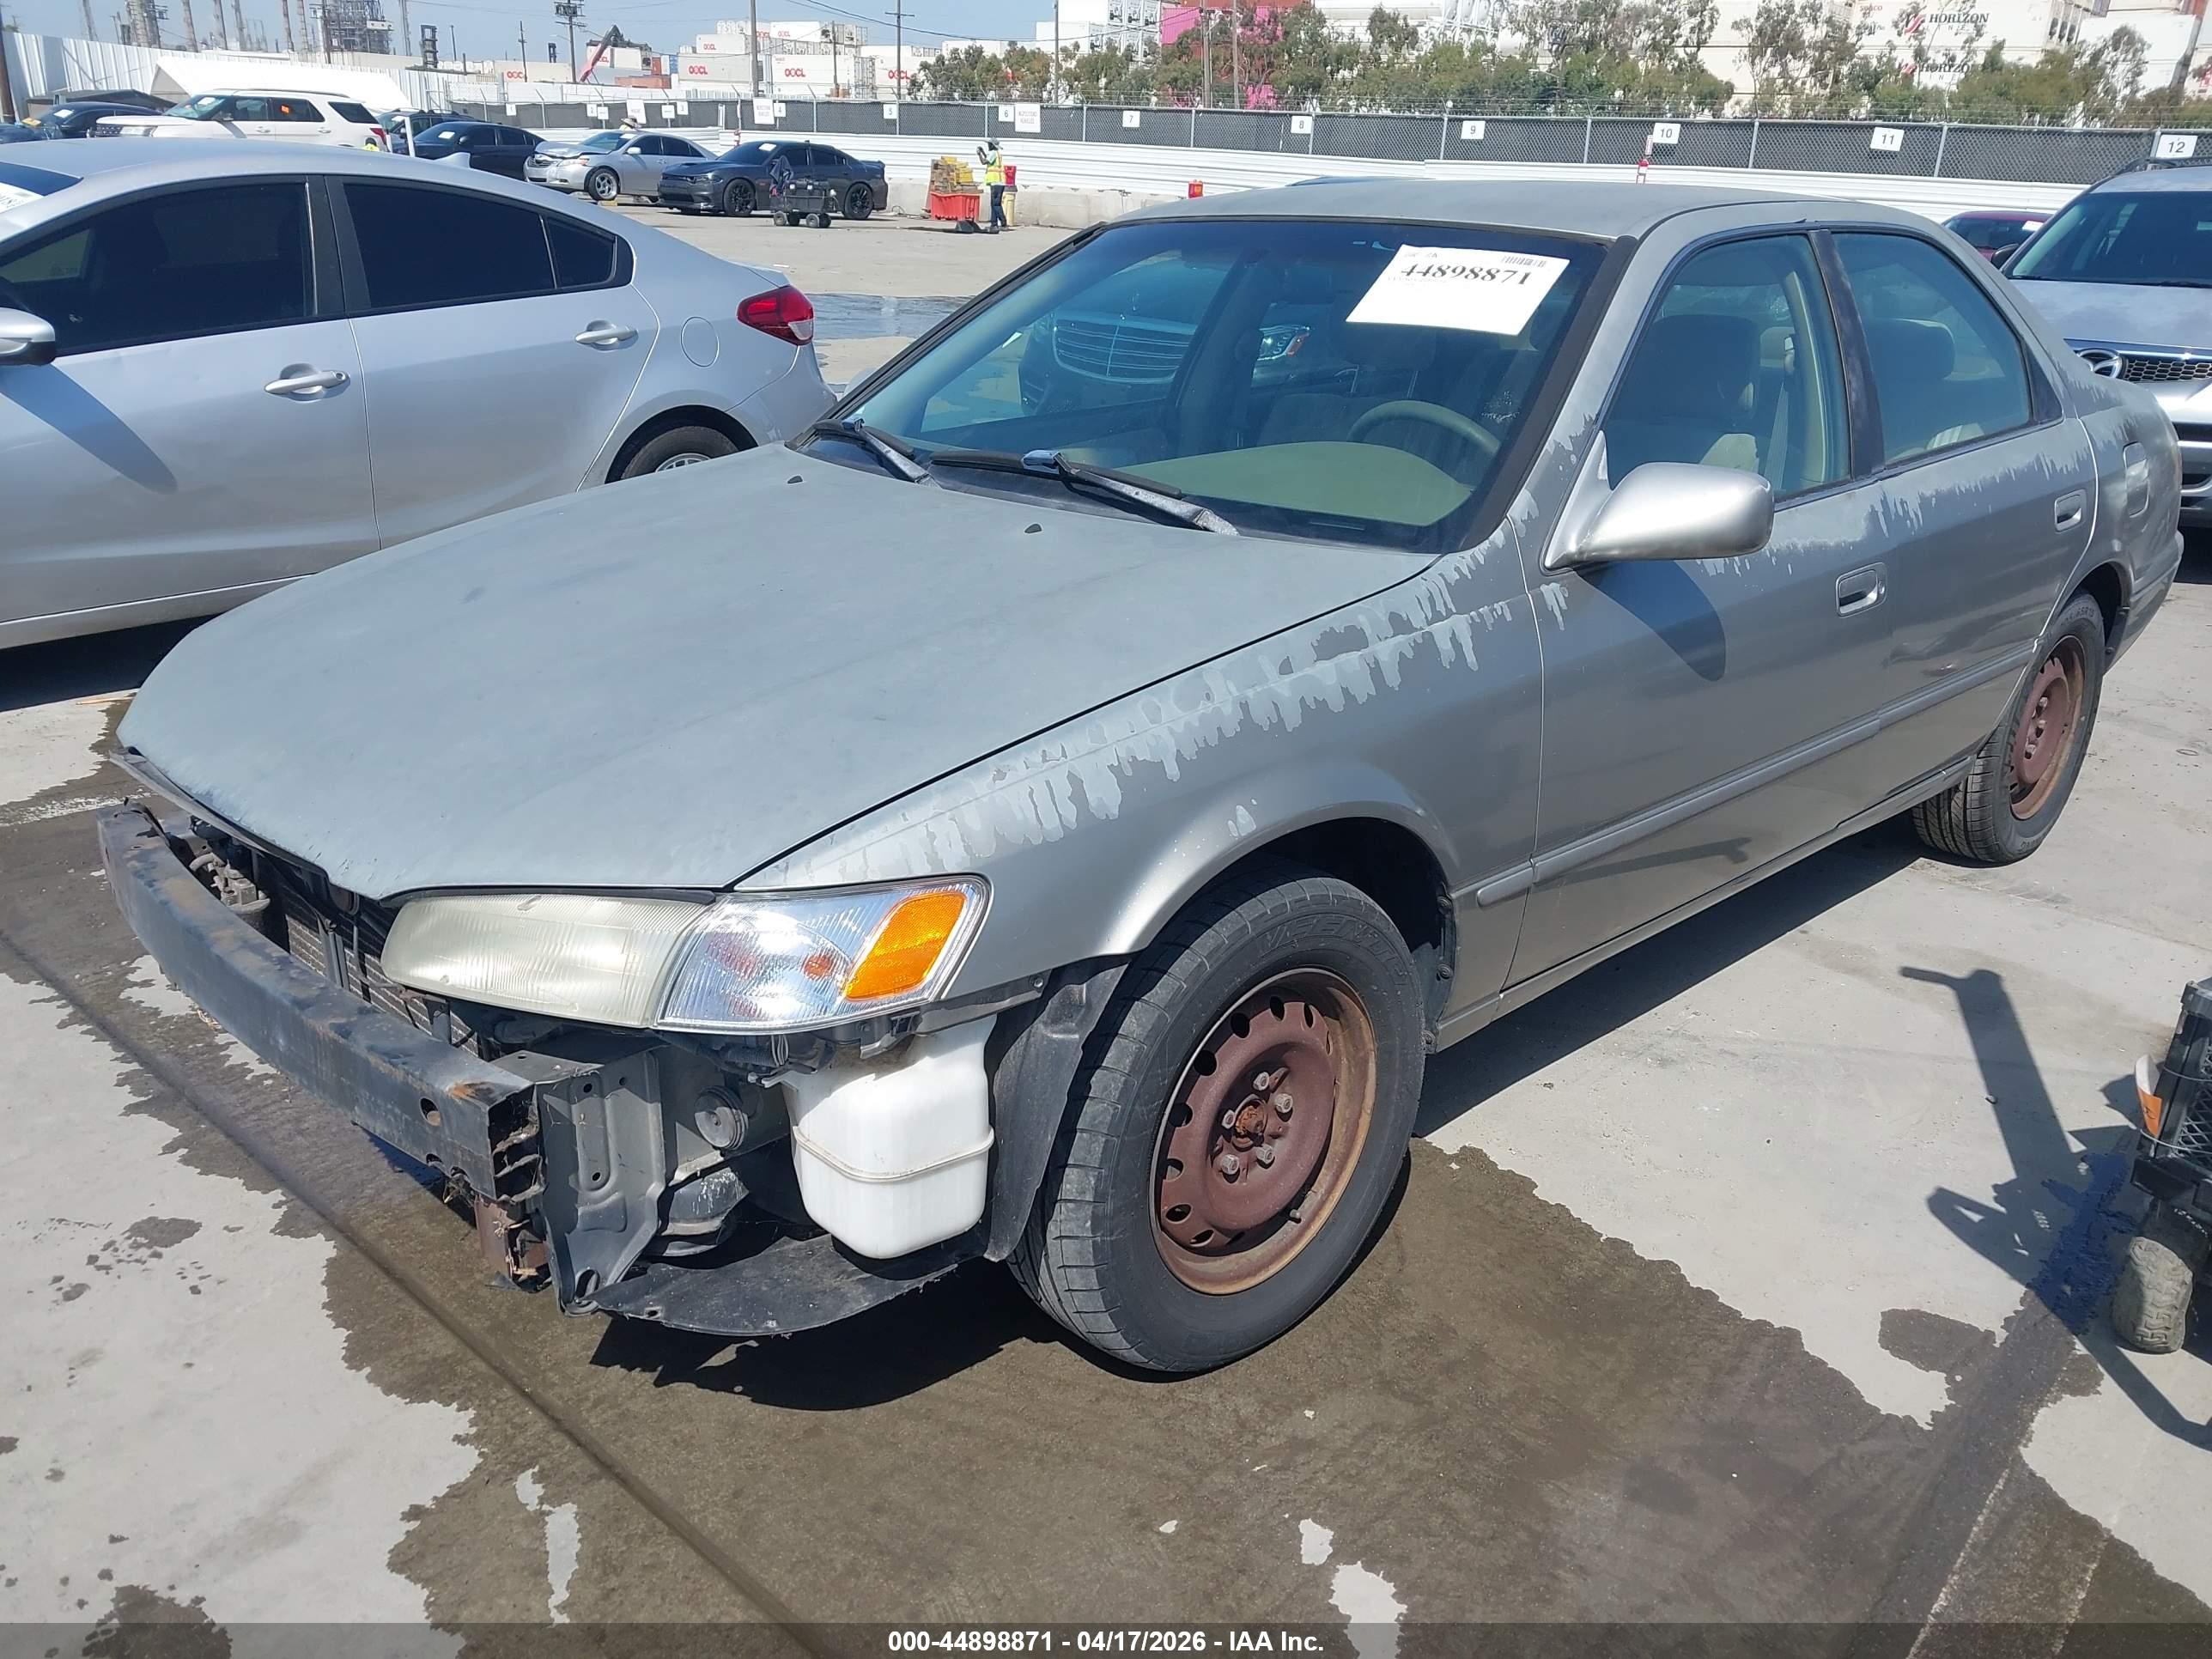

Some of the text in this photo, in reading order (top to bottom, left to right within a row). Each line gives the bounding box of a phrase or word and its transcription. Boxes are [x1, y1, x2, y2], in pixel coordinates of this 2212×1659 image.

[1929, 13, 1990, 23] HORIZON
[689, 65, 708, 75] OOCL
[785, 68, 805, 77] OOCL
[1919, 63, 1971, 74] HORIZO
[888, 107, 893, 116] 5
[1004, 109, 1009, 118] 6
[1298, 119, 1304, 129] 8
[1470, 125, 1476, 135] 9
[1660, 129, 1673, 138] 10
[1881, 133, 1895, 145] 11
[2168, 141, 2185, 153] 12
[1401, 263, 1532, 285] 44898871
